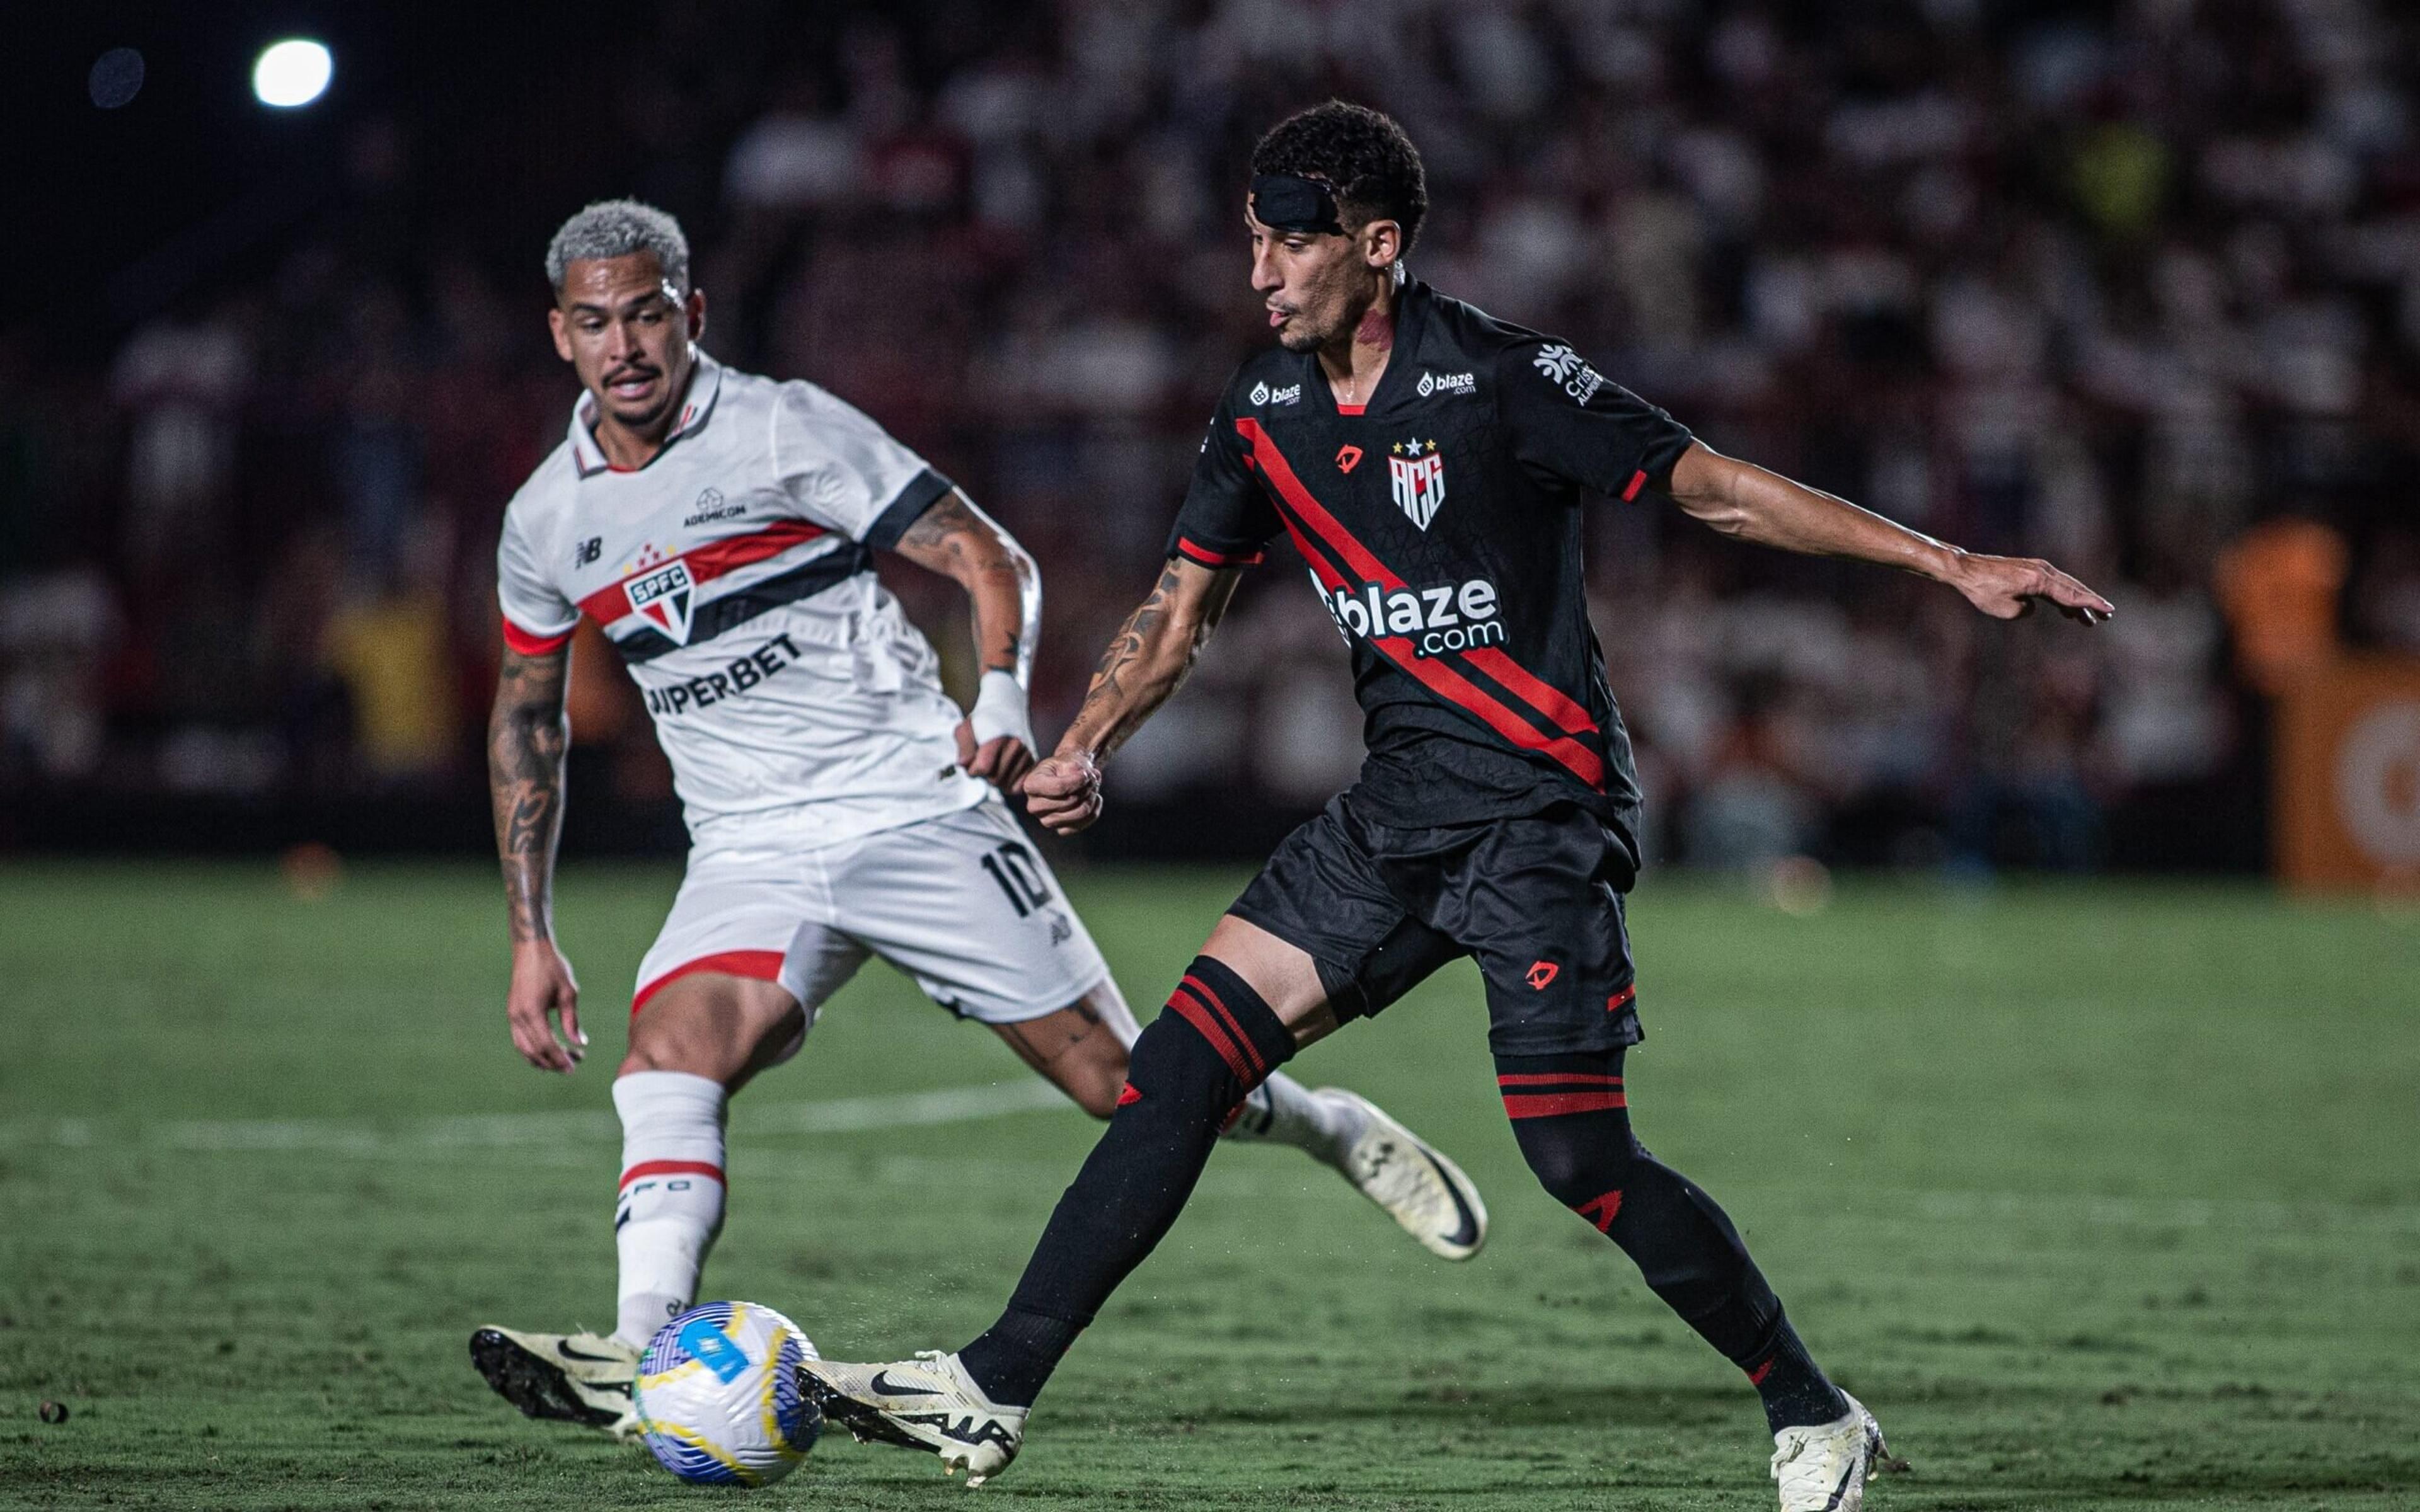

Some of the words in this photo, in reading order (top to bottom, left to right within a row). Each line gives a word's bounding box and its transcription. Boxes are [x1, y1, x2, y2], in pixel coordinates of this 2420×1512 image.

[1271, 384, 1300, 403] blaze
[1436, 373, 1473, 390] blaze
[633, 568, 686, 602] SPFC
[1336, 580, 1497, 638] blaze
[1418, 621, 1504, 656] .com
[981, 842, 1053, 918] 10
